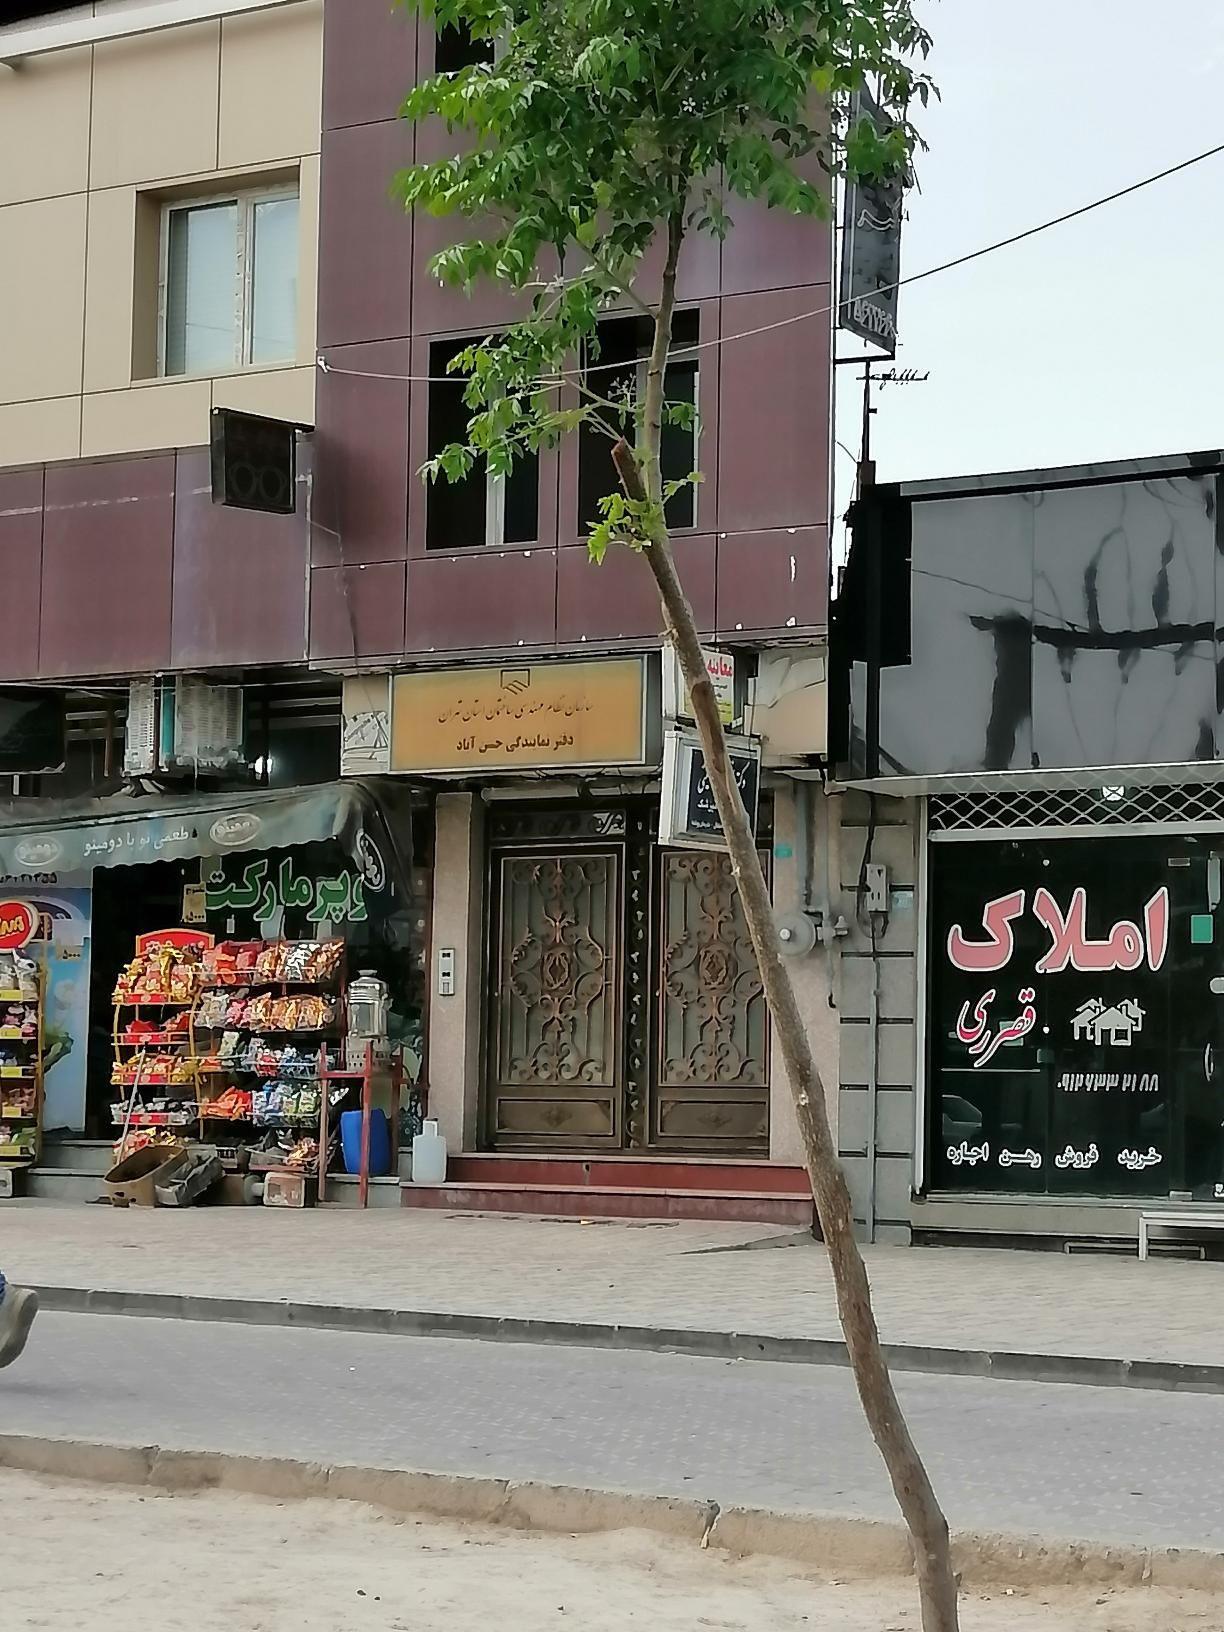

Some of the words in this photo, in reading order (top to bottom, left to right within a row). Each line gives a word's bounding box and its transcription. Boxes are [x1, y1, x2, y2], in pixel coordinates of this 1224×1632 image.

[456, 736, 476, 751] آباد
[479, 739, 503, 753] حسن
[506, 734, 550, 753] نمایندگی
[552, 731, 574, 751] دفتر
[83, 838, 123, 856] دومینو
[947, 887, 1169, 973] املاک
[947, 1141, 989, 1165] اجاره
[999, 1148, 1042, 1168] رهن
[1055, 1143, 1099, 1168] فروش
[1118, 1146, 1162, 1169] خرید
